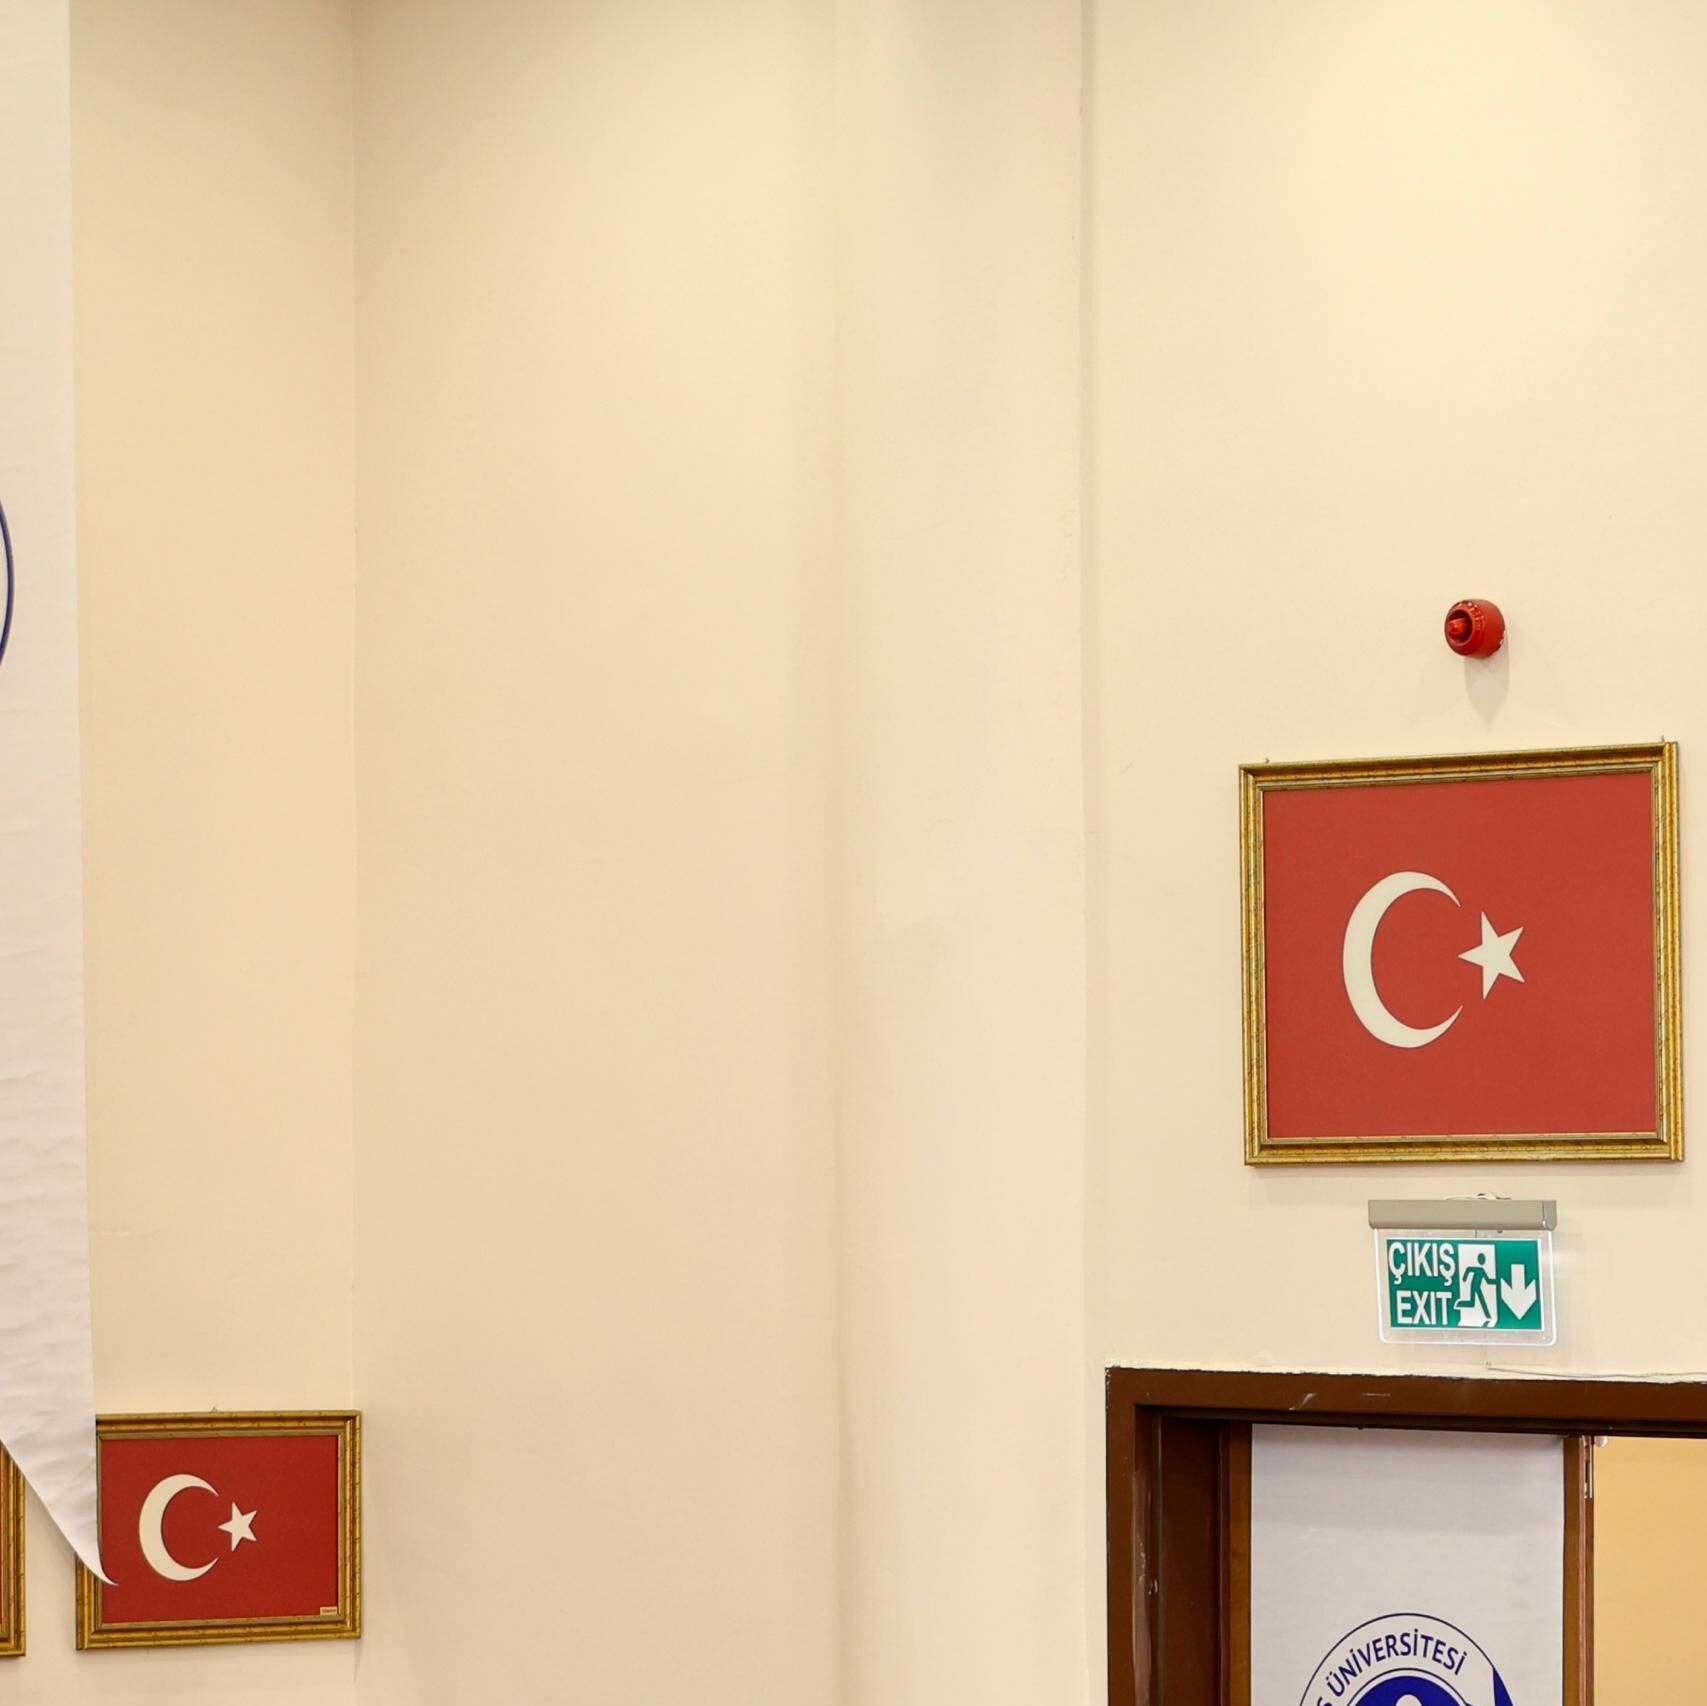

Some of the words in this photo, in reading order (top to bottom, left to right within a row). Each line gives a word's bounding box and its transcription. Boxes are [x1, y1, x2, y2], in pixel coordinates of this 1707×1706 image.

[1388, 1241, 1456, 1287] ÇIKIŞ
[1396, 1290, 1452, 1325] EXIT
[1326, 1628, 1468, 1697] ÜNİVERSİTESİ
